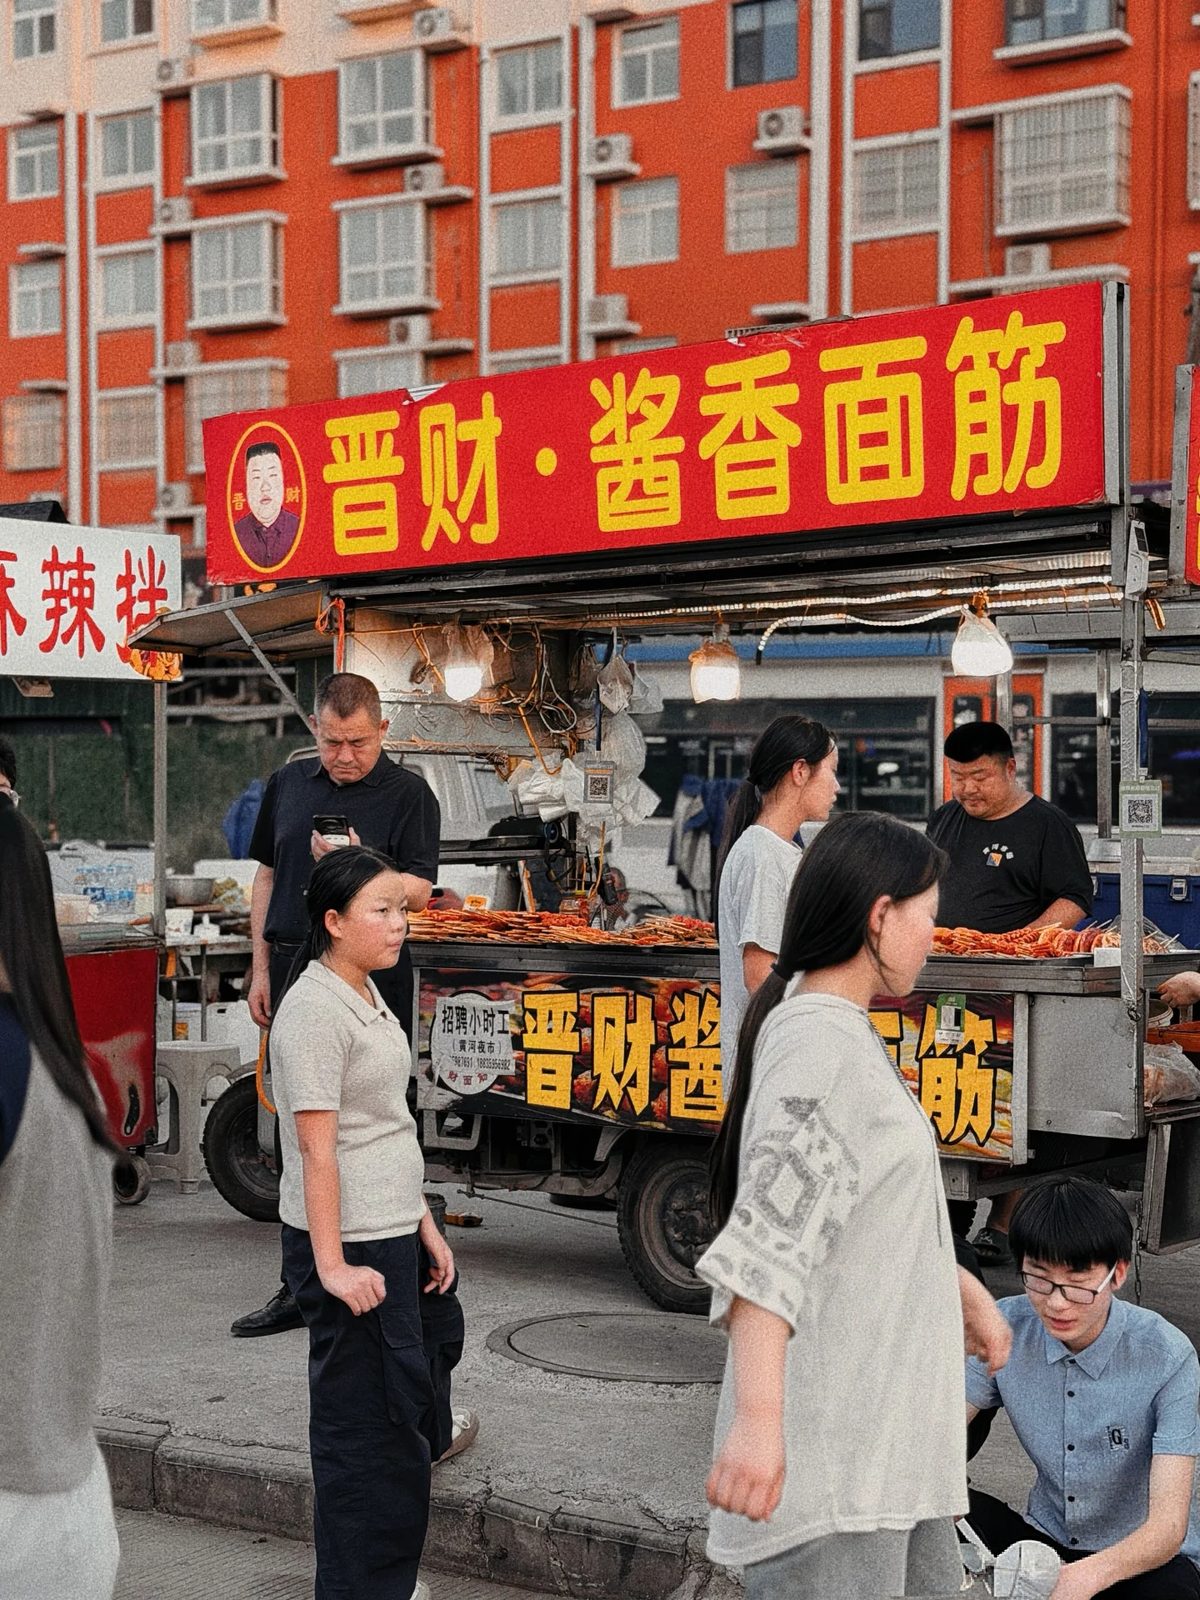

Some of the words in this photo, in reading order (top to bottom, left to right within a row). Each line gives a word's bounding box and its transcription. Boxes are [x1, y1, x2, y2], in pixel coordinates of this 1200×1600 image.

[322, 310, 1067, 558] 晋财·酱香面筋
[442, 1004, 510, 1037] 招聘小时工
